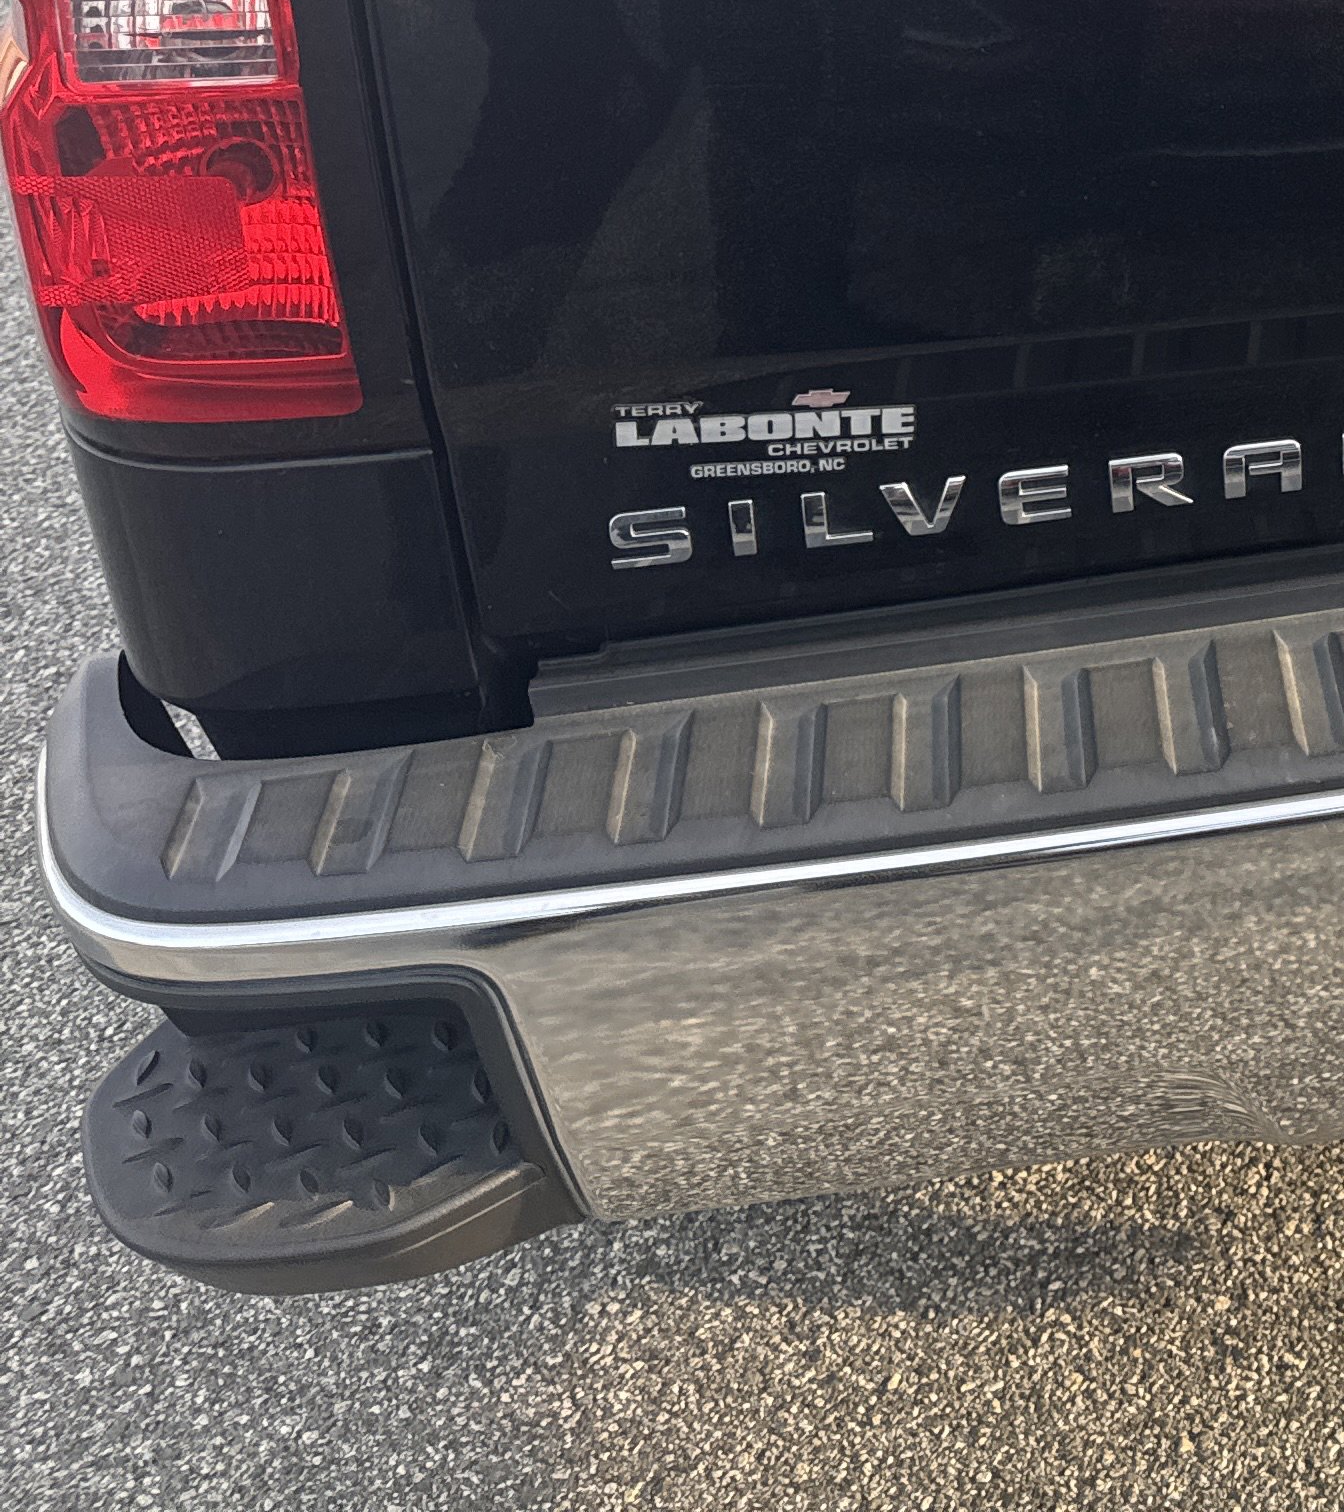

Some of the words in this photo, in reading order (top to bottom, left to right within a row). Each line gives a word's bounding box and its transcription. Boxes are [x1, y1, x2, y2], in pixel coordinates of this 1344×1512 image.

[614, 402, 701, 417] TERRY
[615, 406, 915, 447] LABONTE
[767, 438, 914, 456] CHEVROLET
[690, 459, 815, 478] GREENSBORO,
[819, 458, 846, 472] NC
